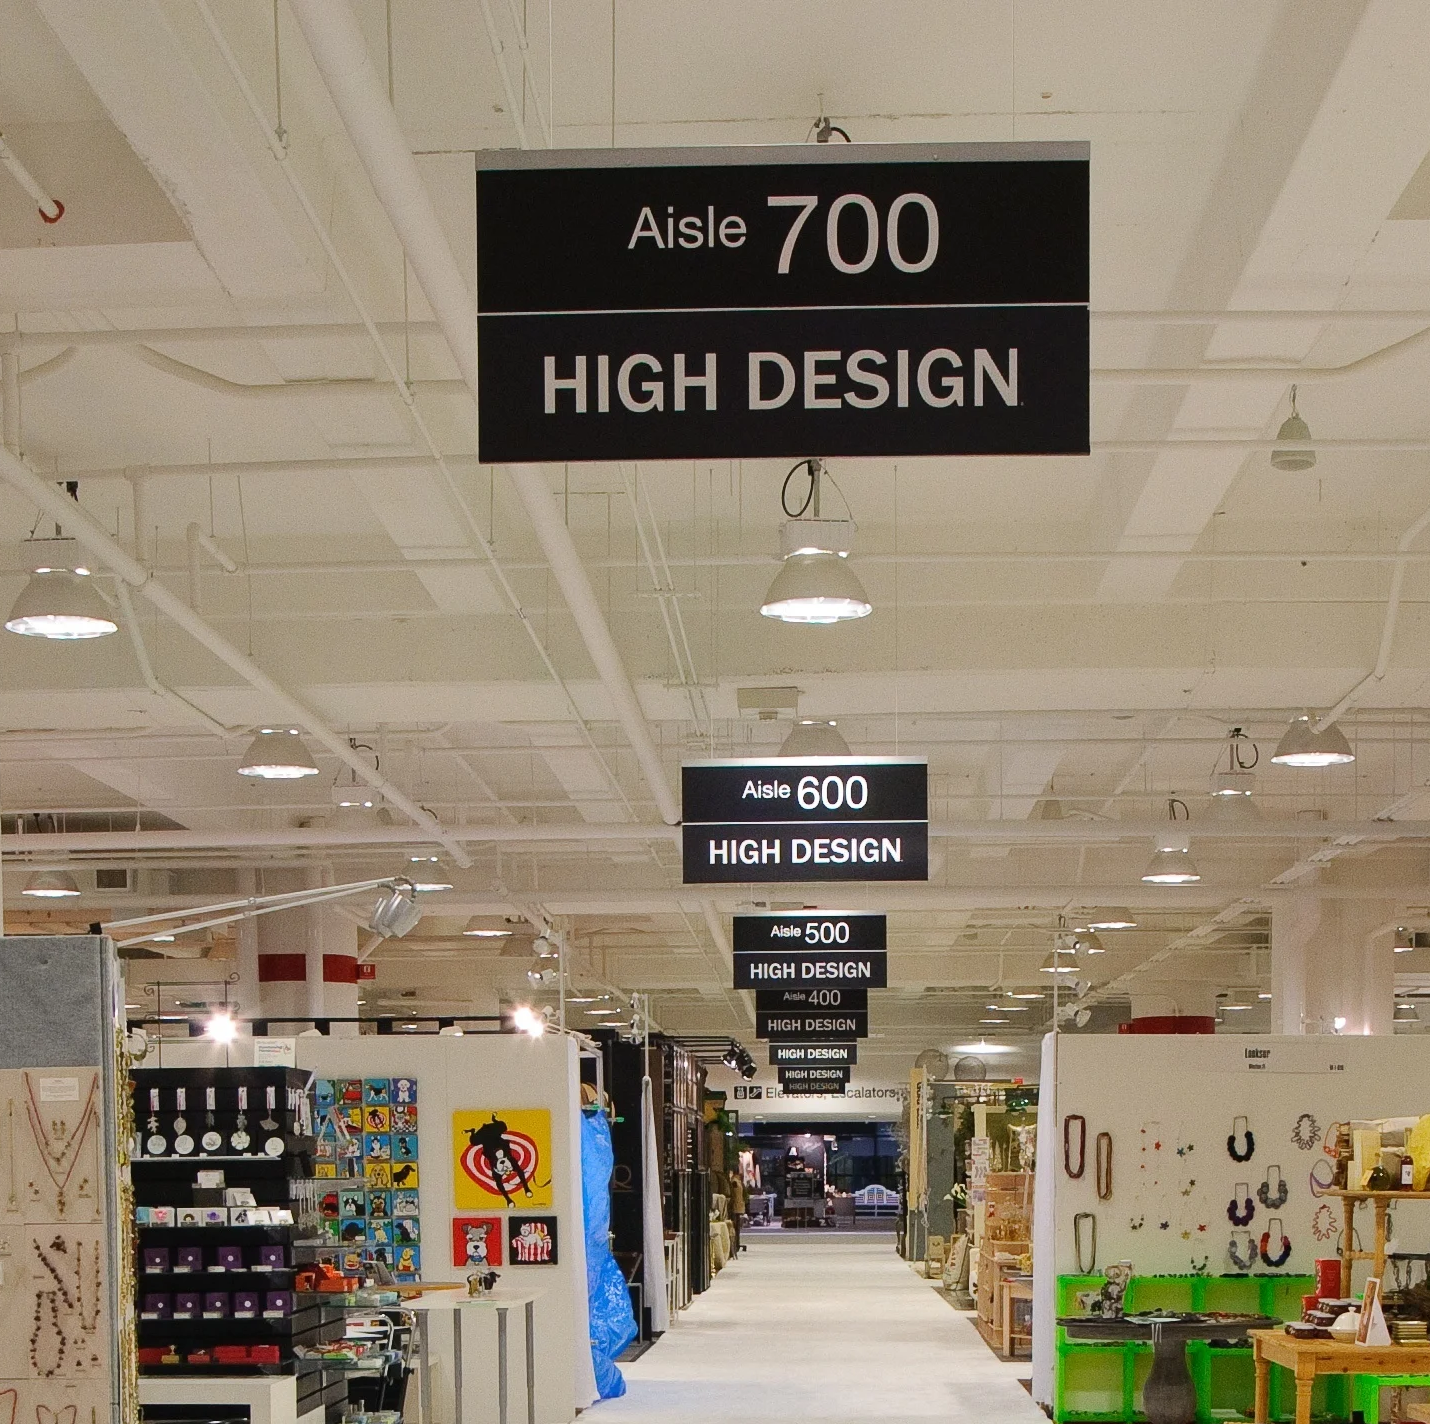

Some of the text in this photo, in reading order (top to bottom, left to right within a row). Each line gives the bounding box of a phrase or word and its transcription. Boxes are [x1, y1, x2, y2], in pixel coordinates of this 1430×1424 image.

[627, 193, 940, 275] Aisle 700
[543, 347, 1019, 415] HIGH DESIGN
[741, 775, 868, 810] Aisle 600
[708, 837, 901, 865] HIGH DESIGN
[770, 921, 850, 944] Aisle 500
[750, 961, 871, 980] HIGH DESIGN
[783, 989, 841, 1006] Aisle 400
[767, 1018, 856, 1032] HIGH DESIGN
[777, 1048, 848, 1059] HIGH DESIGN
[785, 1069, 843, 1079] HIGH DESIGN
[788, 1082, 840, 1091] HIGH DESIGN
[831, 1086, 896, 1099] calators
